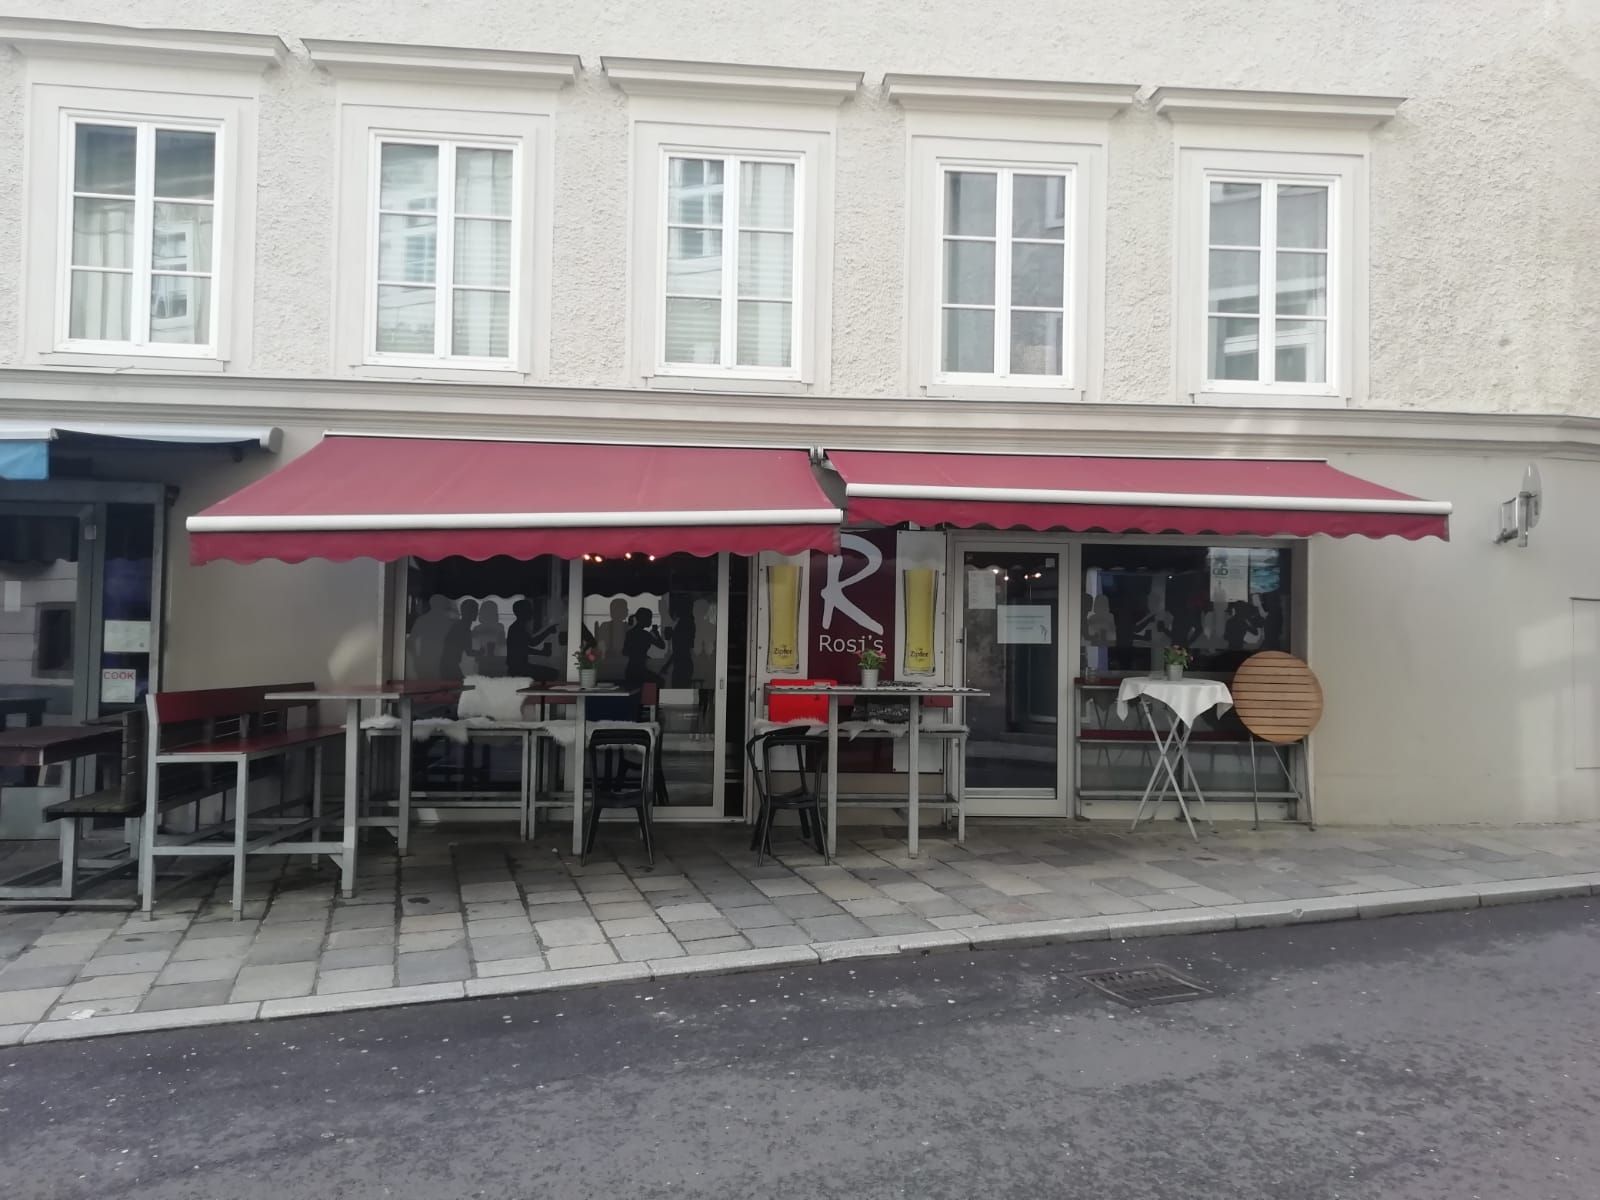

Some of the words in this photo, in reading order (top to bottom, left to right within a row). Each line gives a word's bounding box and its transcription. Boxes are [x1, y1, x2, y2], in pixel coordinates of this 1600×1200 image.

[820, 533, 883, 635] R
[819, 635, 884, 652] Rosi's
[103, 671, 135, 680] COOK
